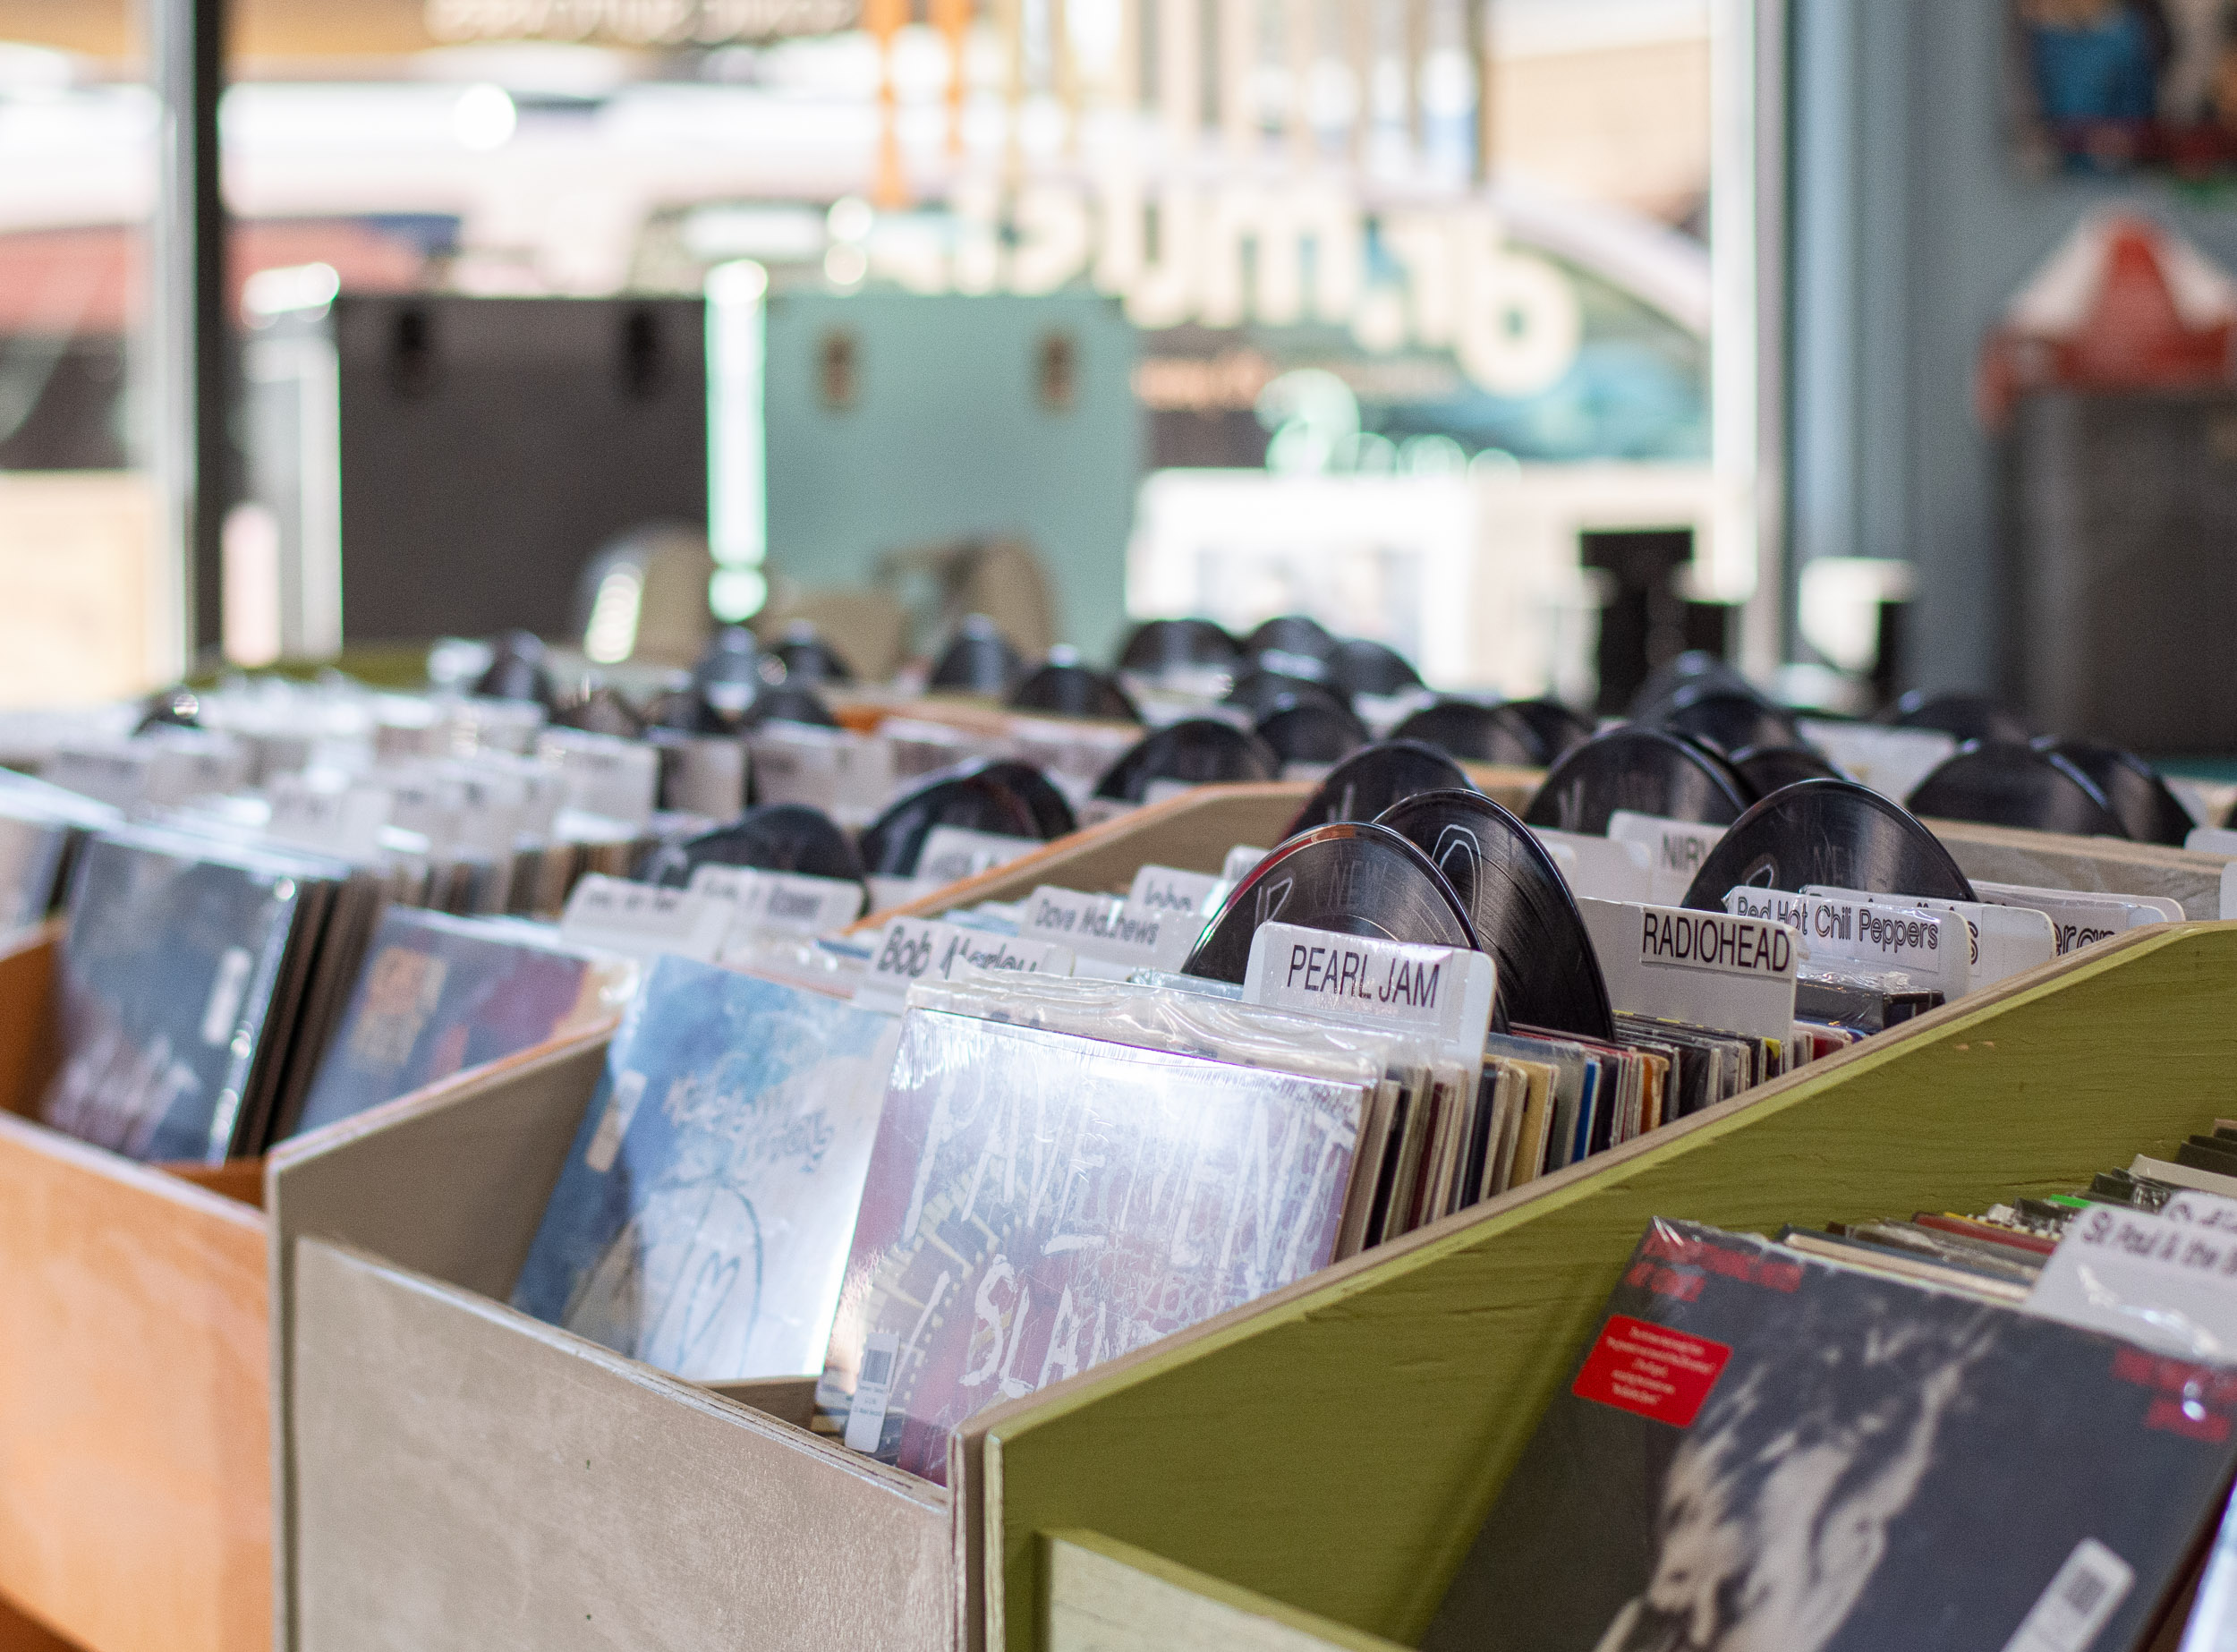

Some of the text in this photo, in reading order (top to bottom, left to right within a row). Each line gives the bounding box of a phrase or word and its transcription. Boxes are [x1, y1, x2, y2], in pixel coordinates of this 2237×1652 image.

[877, 924, 932, 978] Bob
[1642, 912, 1790, 972] RADIOHEAD
[1776, 899, 1808, 935] Hot
[1814, 904, 1852, 941] Chili
[1858, 908, 1939, 954] Peppers
[1287, 944, 1441, 1009] PEARL JAM
